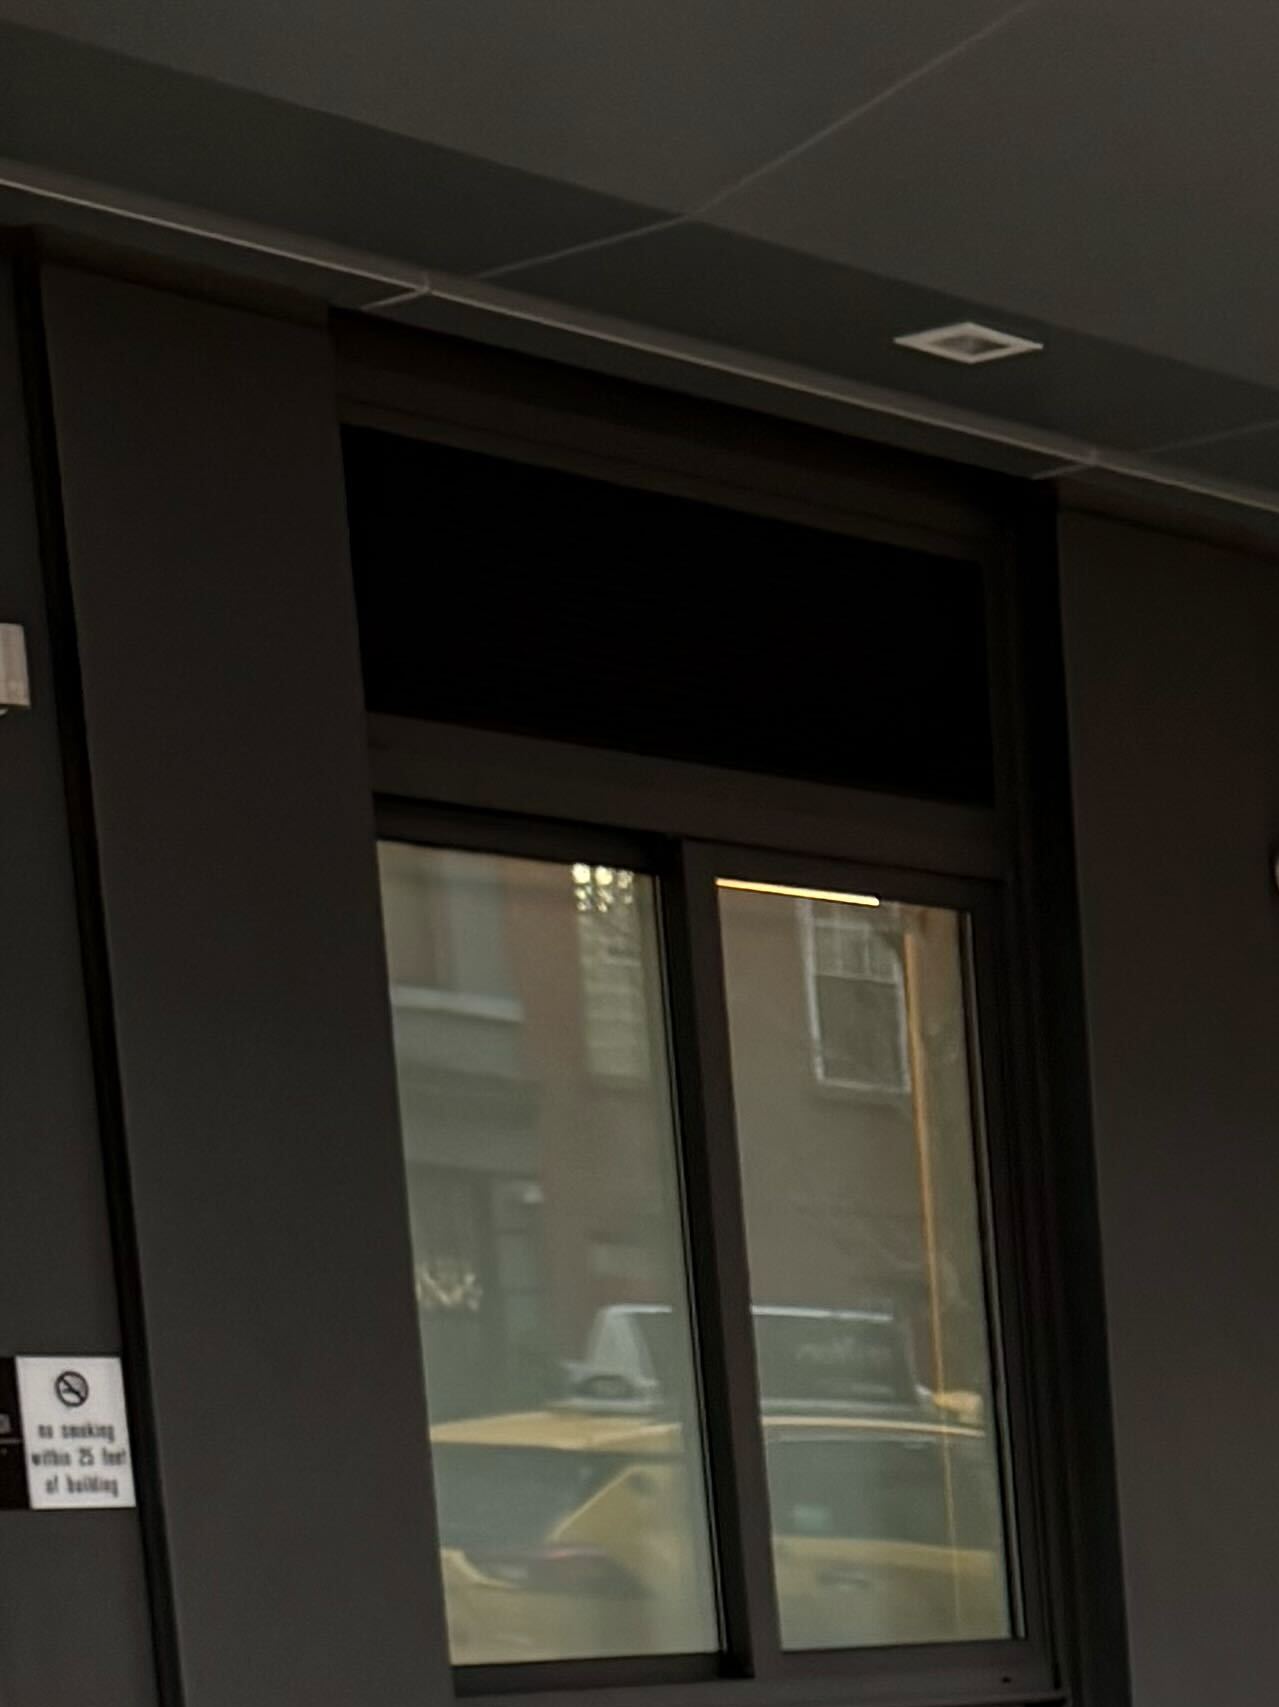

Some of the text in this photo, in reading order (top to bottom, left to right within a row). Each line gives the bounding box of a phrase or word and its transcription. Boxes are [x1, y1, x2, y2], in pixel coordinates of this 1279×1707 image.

[38, 1422, 115, 1443] no smoking
[31, 1449, 70, 1467] within
[79, 1448, 94, 1467] 25
[46, 1474, 119, 1498] of building
